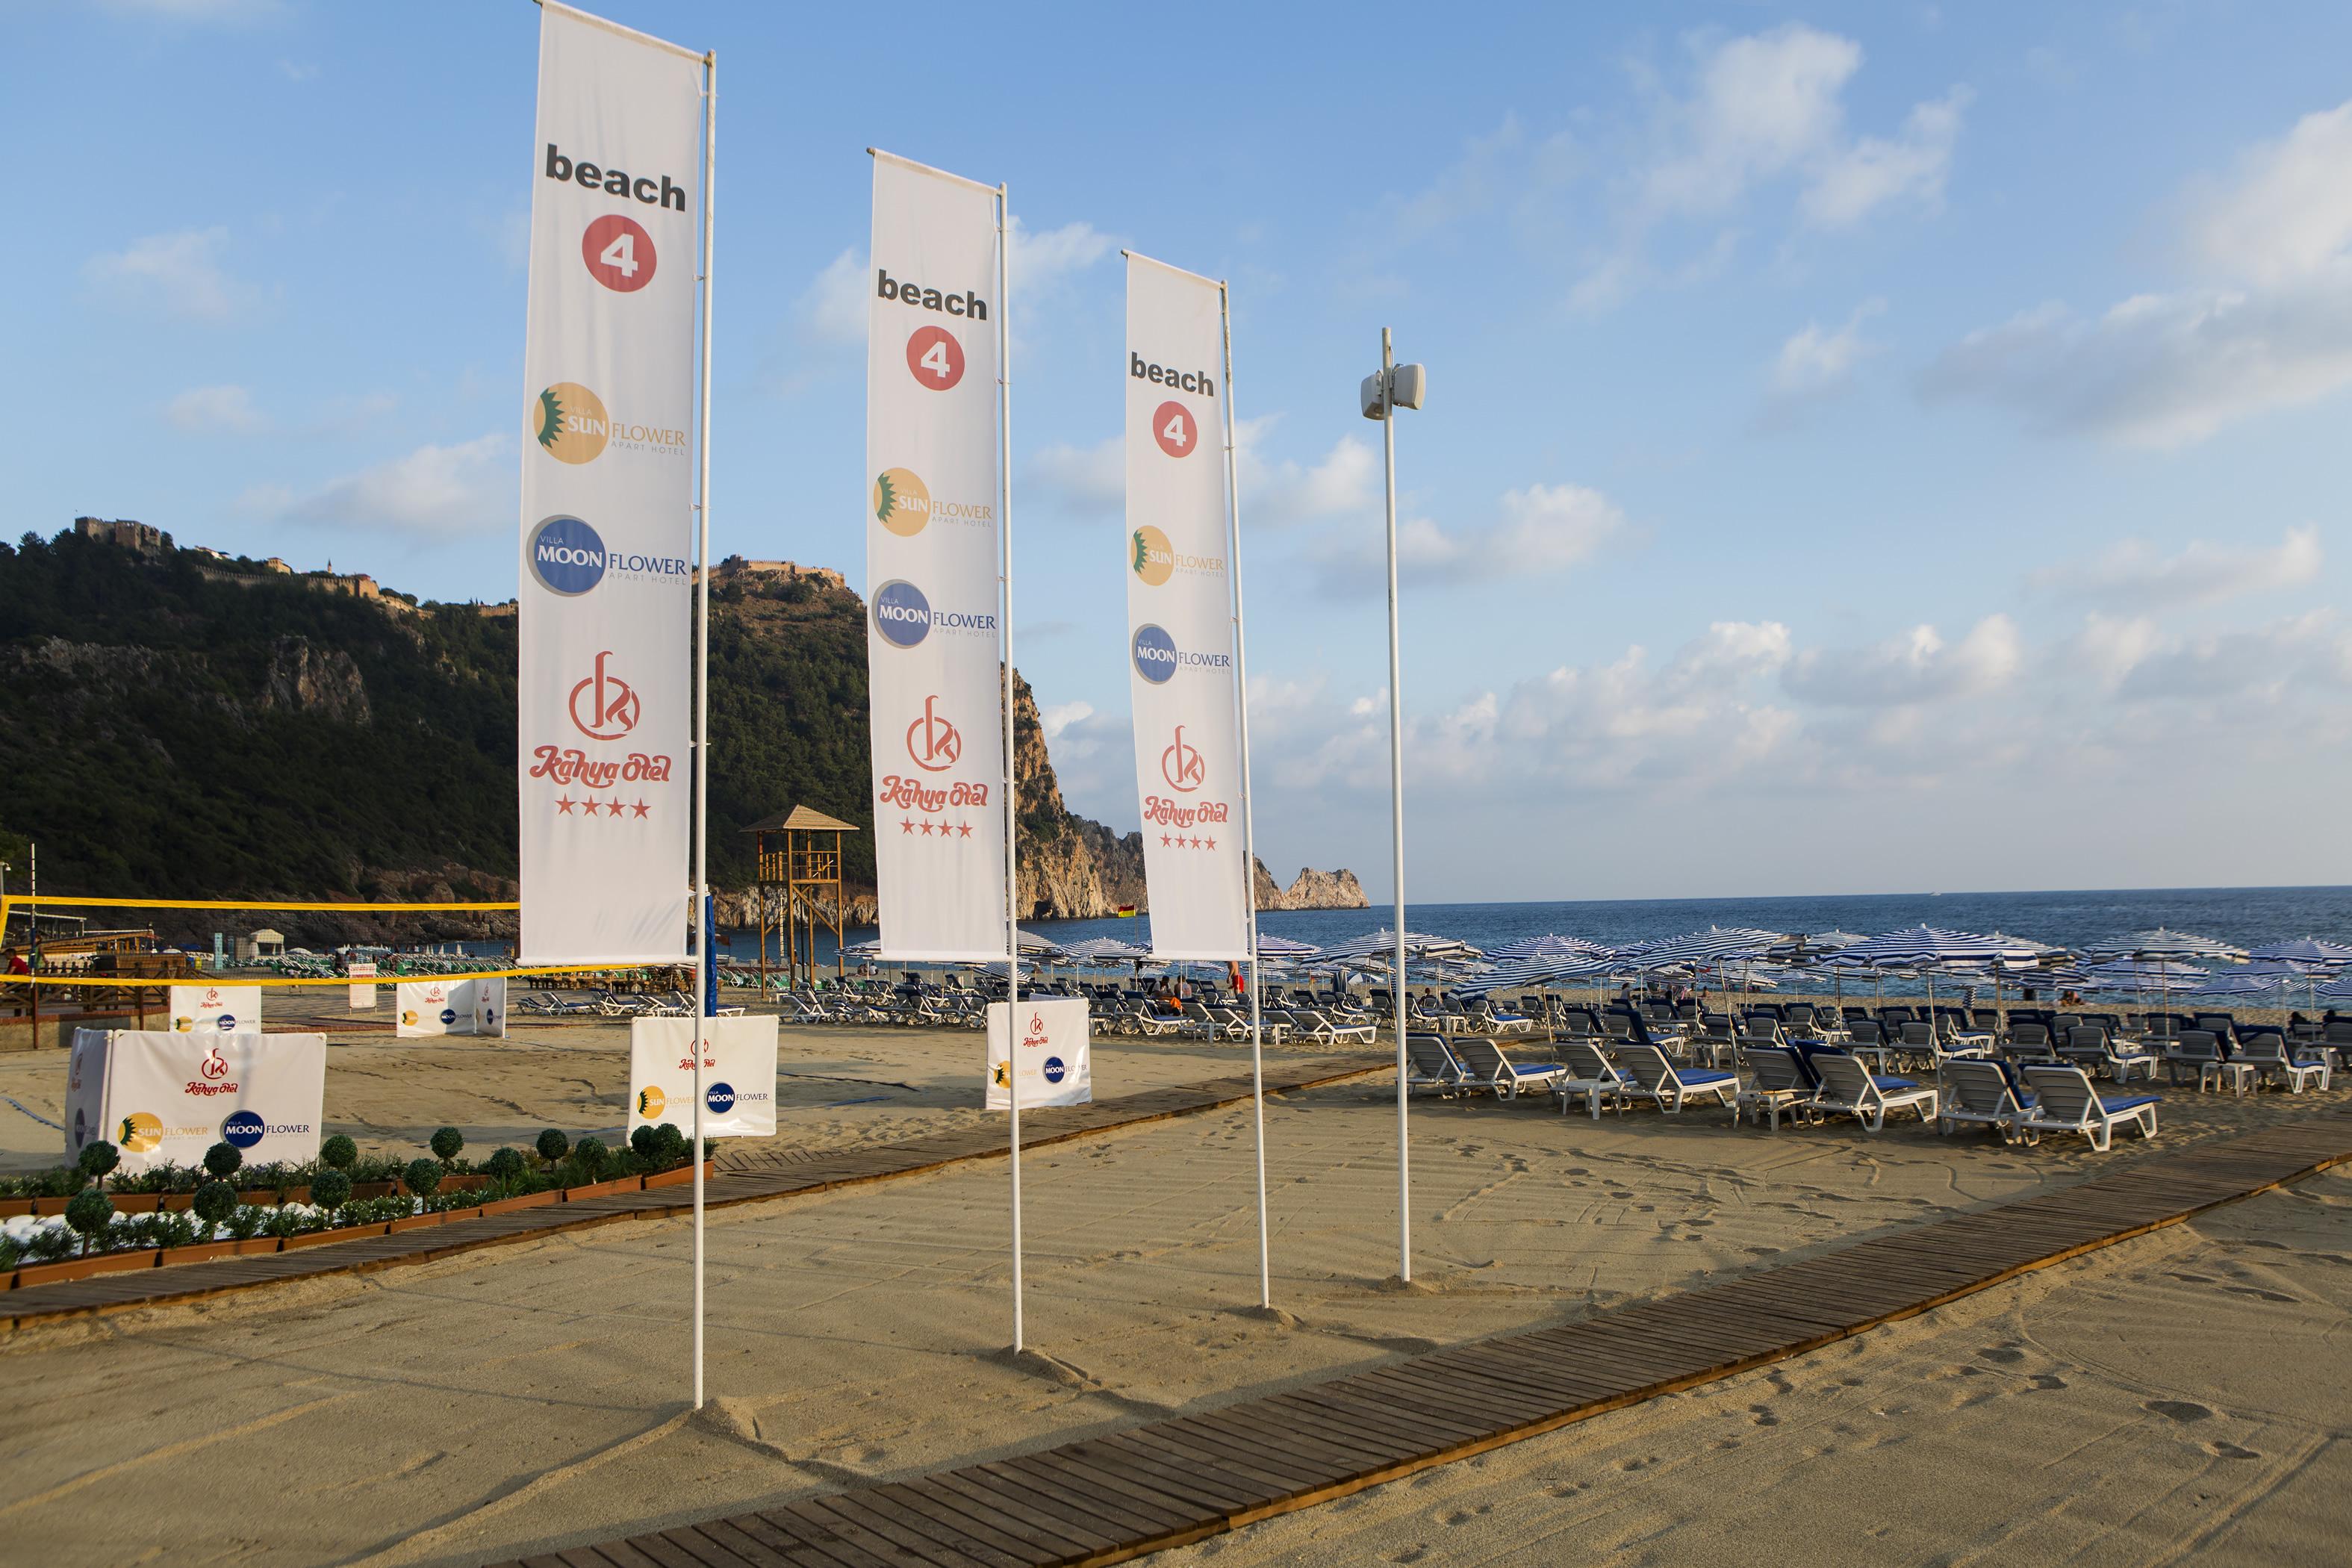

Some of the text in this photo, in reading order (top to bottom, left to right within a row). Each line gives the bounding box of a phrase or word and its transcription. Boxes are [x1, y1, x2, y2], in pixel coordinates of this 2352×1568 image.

[546, 143, 685, 212] beach
[600, 233, 638, 278] 4
[877, 268, 987, 321] beach
[921, 340, 951, 379] 4
[1131, 351, 1214, 397] beach
[570, 405, 592, 416] VILLA
[567, 415, 686, 446] SUN FLOWER
[1163, 414, 1186, 447] 4
[612, 441, 685, 455] APART HOTEL
[898, 495, 992, 520] SUN FLOWER
[932, 516, 959, 524] APART
[540, 535, 564, 544] VILLA
[537, 544, 687, 575] MOON FLOWER
[1149, 550, 1224, 570] SUN FLOWER
[609, 572, 686, 585] APART HOTEL
[879, 604, 996, 629] MOON FLOWER
[967, 630, 995, 638] HOTEL
[1137, 646, 1230, 668] MOON FLOWER
[529, 745, 671, 789] Kahya Otel
[880, 775, 989, 812] Kahya Otel
[1144, 795, 1228, 828] Kahya Otel
[1065, 1064, 1087, 1072] FLOER
[185, 1082, 238, 1096] Kahya Otel
[708, 1094, 734, 1103] MOON
[650, 1098, 665, 1107] SUN
[137, 1127, 208, 1136] SUN FLOWER
[225, 1124, 310, 1134] MOON FLOWER
